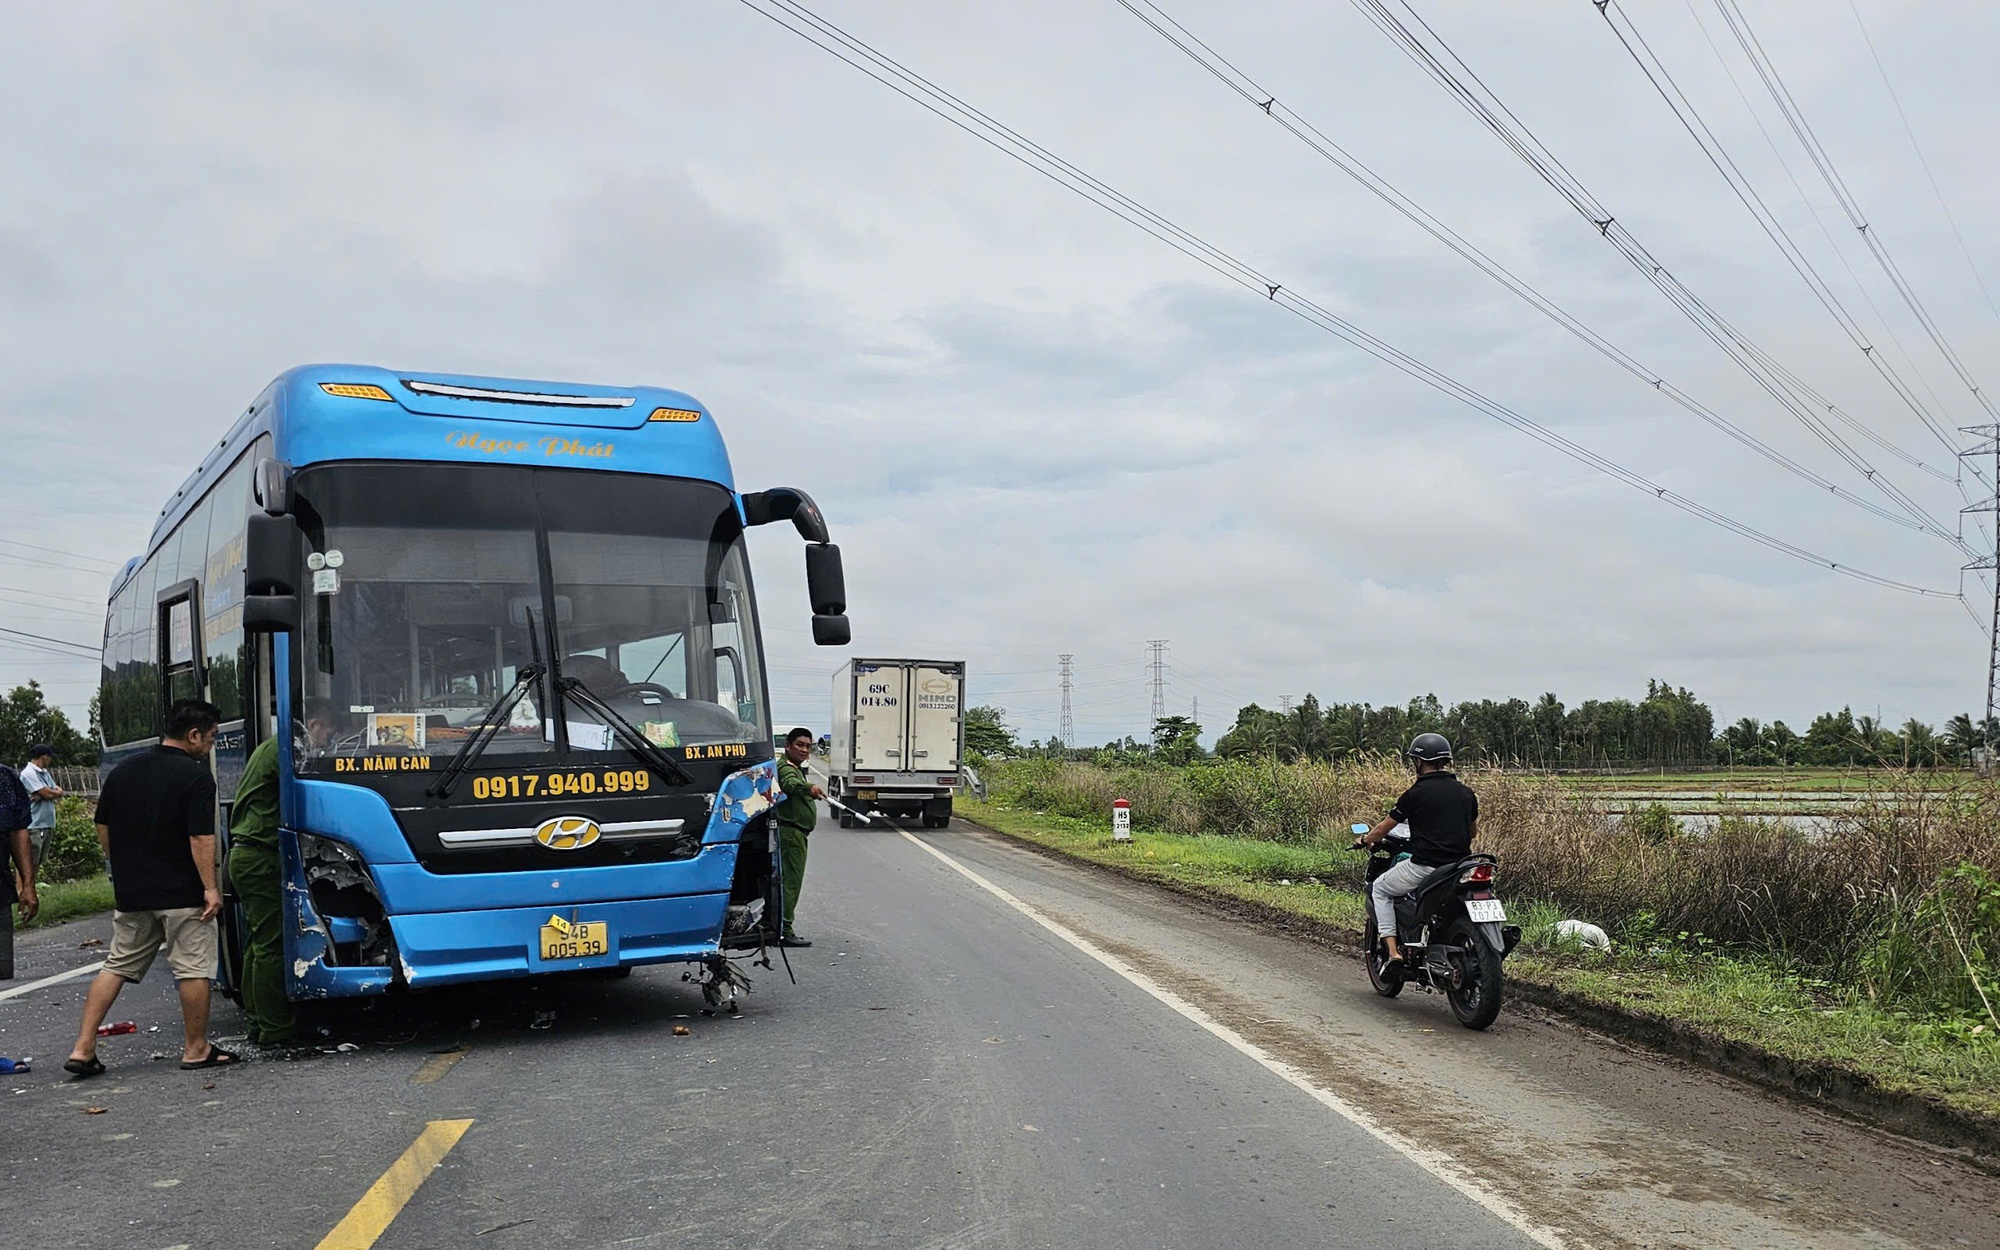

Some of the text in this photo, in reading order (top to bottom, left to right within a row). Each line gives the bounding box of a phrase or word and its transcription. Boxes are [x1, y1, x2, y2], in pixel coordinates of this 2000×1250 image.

[445, 431, 615, 458] Ngọc Phát
[869, 684, 890, 694] 69C
[861, 697, 897, 707] 014.80
[918, 694, 957, 703] HINO
[685, 746, 705, 760] BX.
[707, 744, 723, 758] AN
[335, 758, 360, 772] BX.
[473, 770, 650, 799] 0917.940.999
[556, 918, 568, 930] 14
